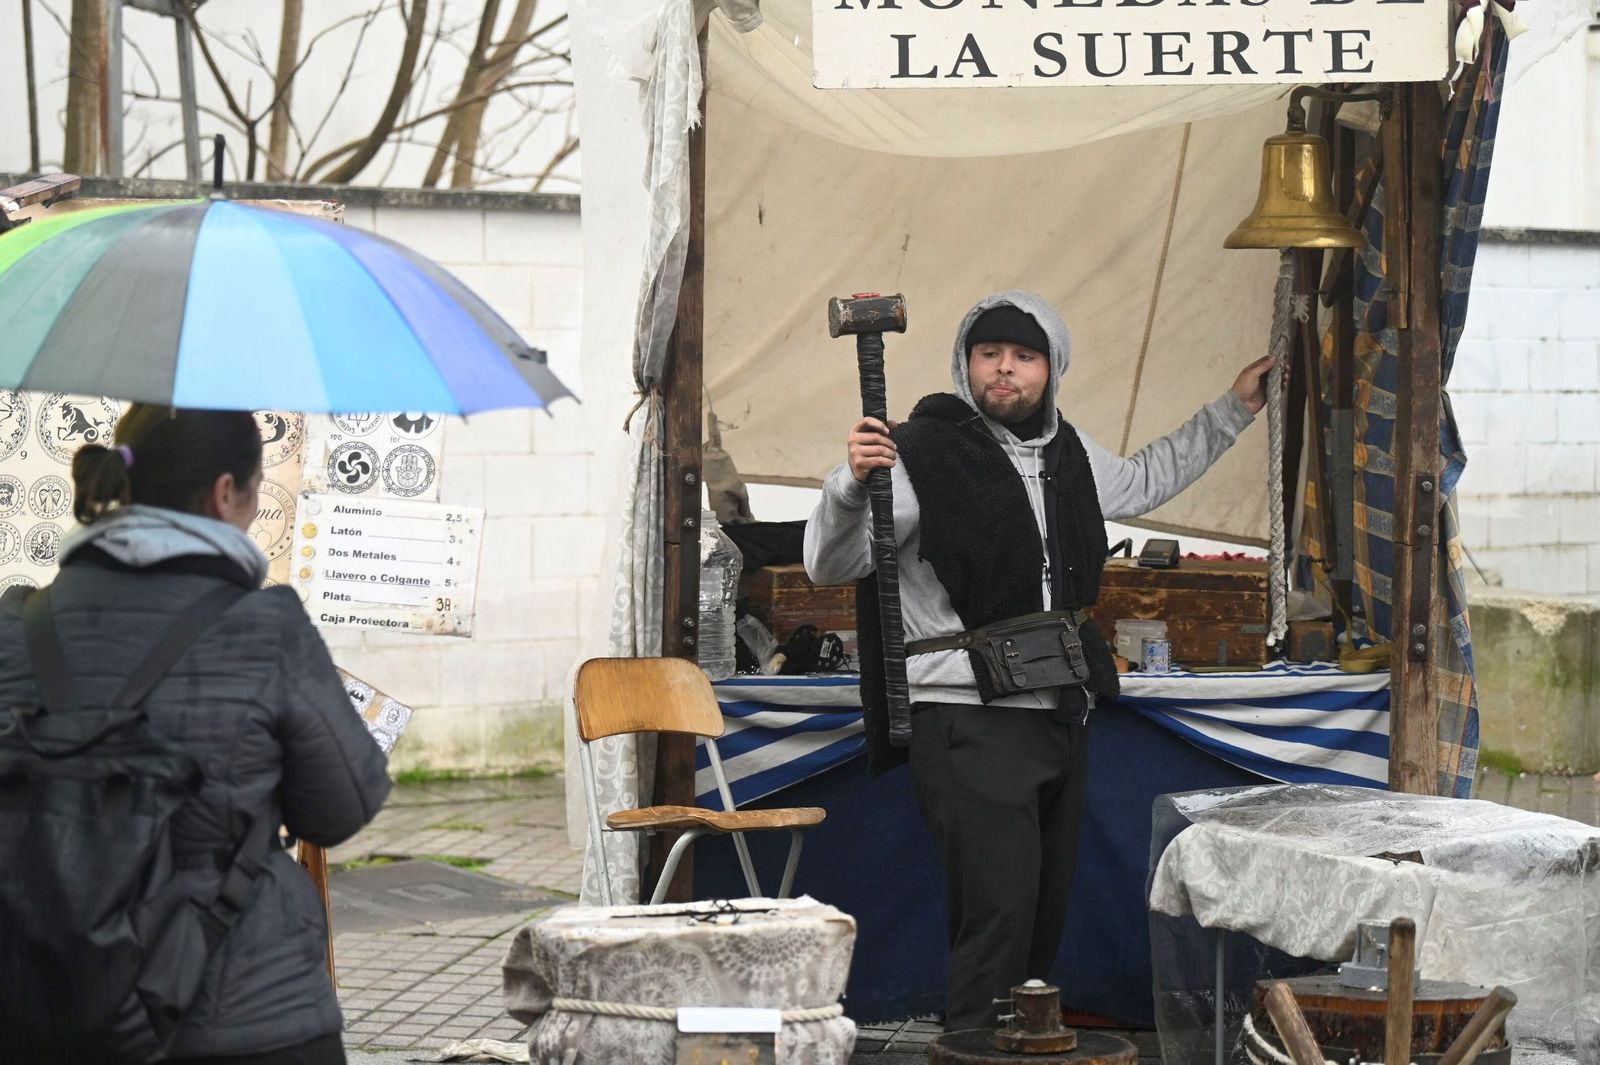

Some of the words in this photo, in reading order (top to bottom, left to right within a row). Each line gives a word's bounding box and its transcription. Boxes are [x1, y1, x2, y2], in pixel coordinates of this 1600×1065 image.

[890, 33, 998, 79] LA
[1033, 28, 1374, 78] SUERTE
[20, 450, 28, 460] 9
[263, 484, 274, 493] LA
[333, 505, 382, 517] Aluminio
[330, 526, 362, 536] Latón
[449, 535, 456, 544] 3
[328, 548, 349, 557] Dos
[352, 549, 397, 561] Metales
[447, 557, 453, 566] 4
[325, 569, 367, 581] Llavero
[370, 573, 377, 581] o
[380, 574, 431, 586] Colgante
[444, 579, 451, 587] 5
[322, 591, 352, 602] Plata
[320, 613, 346, 624] Caja
[348, 615, 409, 629] Protectora
